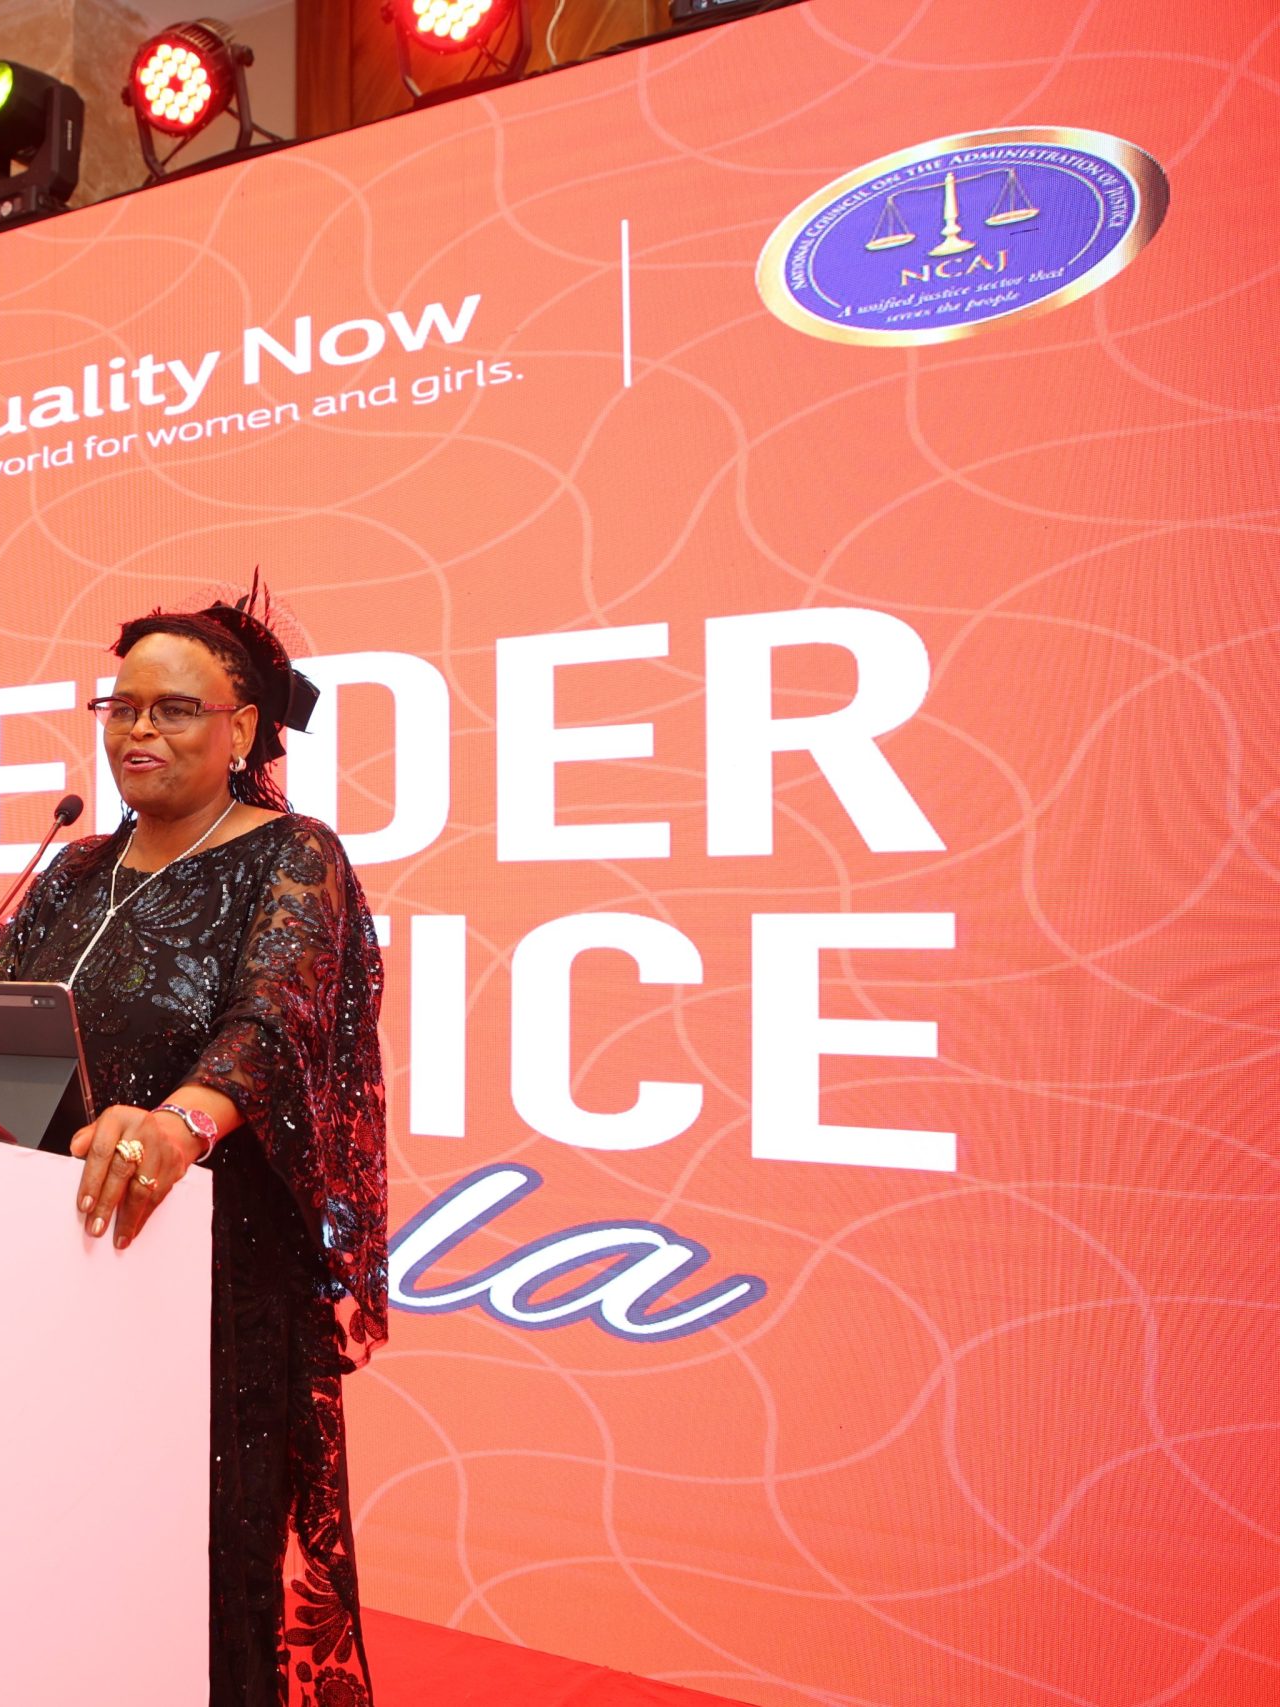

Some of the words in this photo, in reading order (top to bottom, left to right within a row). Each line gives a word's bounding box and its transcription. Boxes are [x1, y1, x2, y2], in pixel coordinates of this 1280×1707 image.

[871, 173, 902, 191] ON
[907, 160, 943, 177] THE
[950, 147, 1103, 180] ADMINISTRATION
[1098, 170, 1118, 187] OF
[805, 188, 871, 238] COUNCIL
[1104, 183, 1129, 229] JUSTICE
[791, 238, 815, 291] NATIONAL
[900, 249, 1008, 287] NCAJ
[837, 305, 852, 318] A
[857, 293, 915, 314] unified
[914, 285, 970, 307] justice
[975, 275, 1024, 293] sector
[1028, 267, 1065, 283] that
[886, 309, 931, 324] serves
[936, 301, 962, 315] the
[964, 292, 1020, 312] people
[243, 294, 481, 386] Now
[83, 433, 138, 460] for
[146, 403, 300, 448] women
[312, 377, 398, 418] and
[411, 361, 524, 406] girls.
